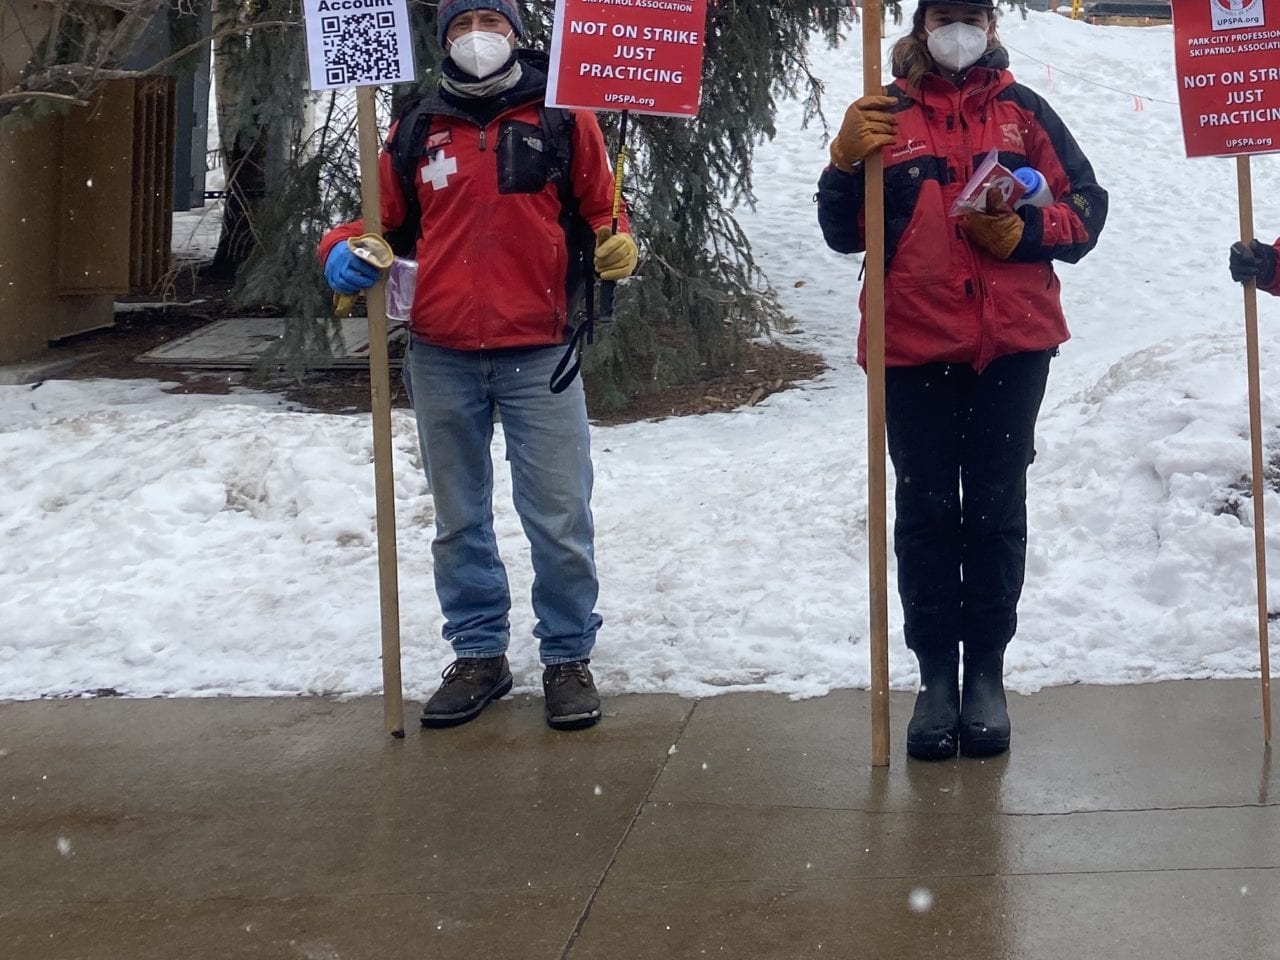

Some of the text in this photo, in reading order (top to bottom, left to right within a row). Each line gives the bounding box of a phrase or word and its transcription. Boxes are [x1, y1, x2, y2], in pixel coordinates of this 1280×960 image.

[635, 0, 692, 13] ASSOCIATION
[1217, 17, 1259, 25] UPSPA.org
[570, 20, 698, 45] NOT ON STRIKE
[1188, 36, 1210, 46] PARK
[1211, 35, 1229, 44] CITY
[613, 45, 655, 61] JUST
[1189, 48, 1203, 57] SKI
[1204, 45, 1236, 56] PATROL
[579, 63, 683, 84] PRACTICING
[1184, 73, 1216, 89] NOT
[1221, 71, 1245, 85] ON
[604, 93, 655, 107] UPSPA.org
[1226, 89, 1264, 105] JUST
[1225, 136, 1272, 148] UPSPA.org
